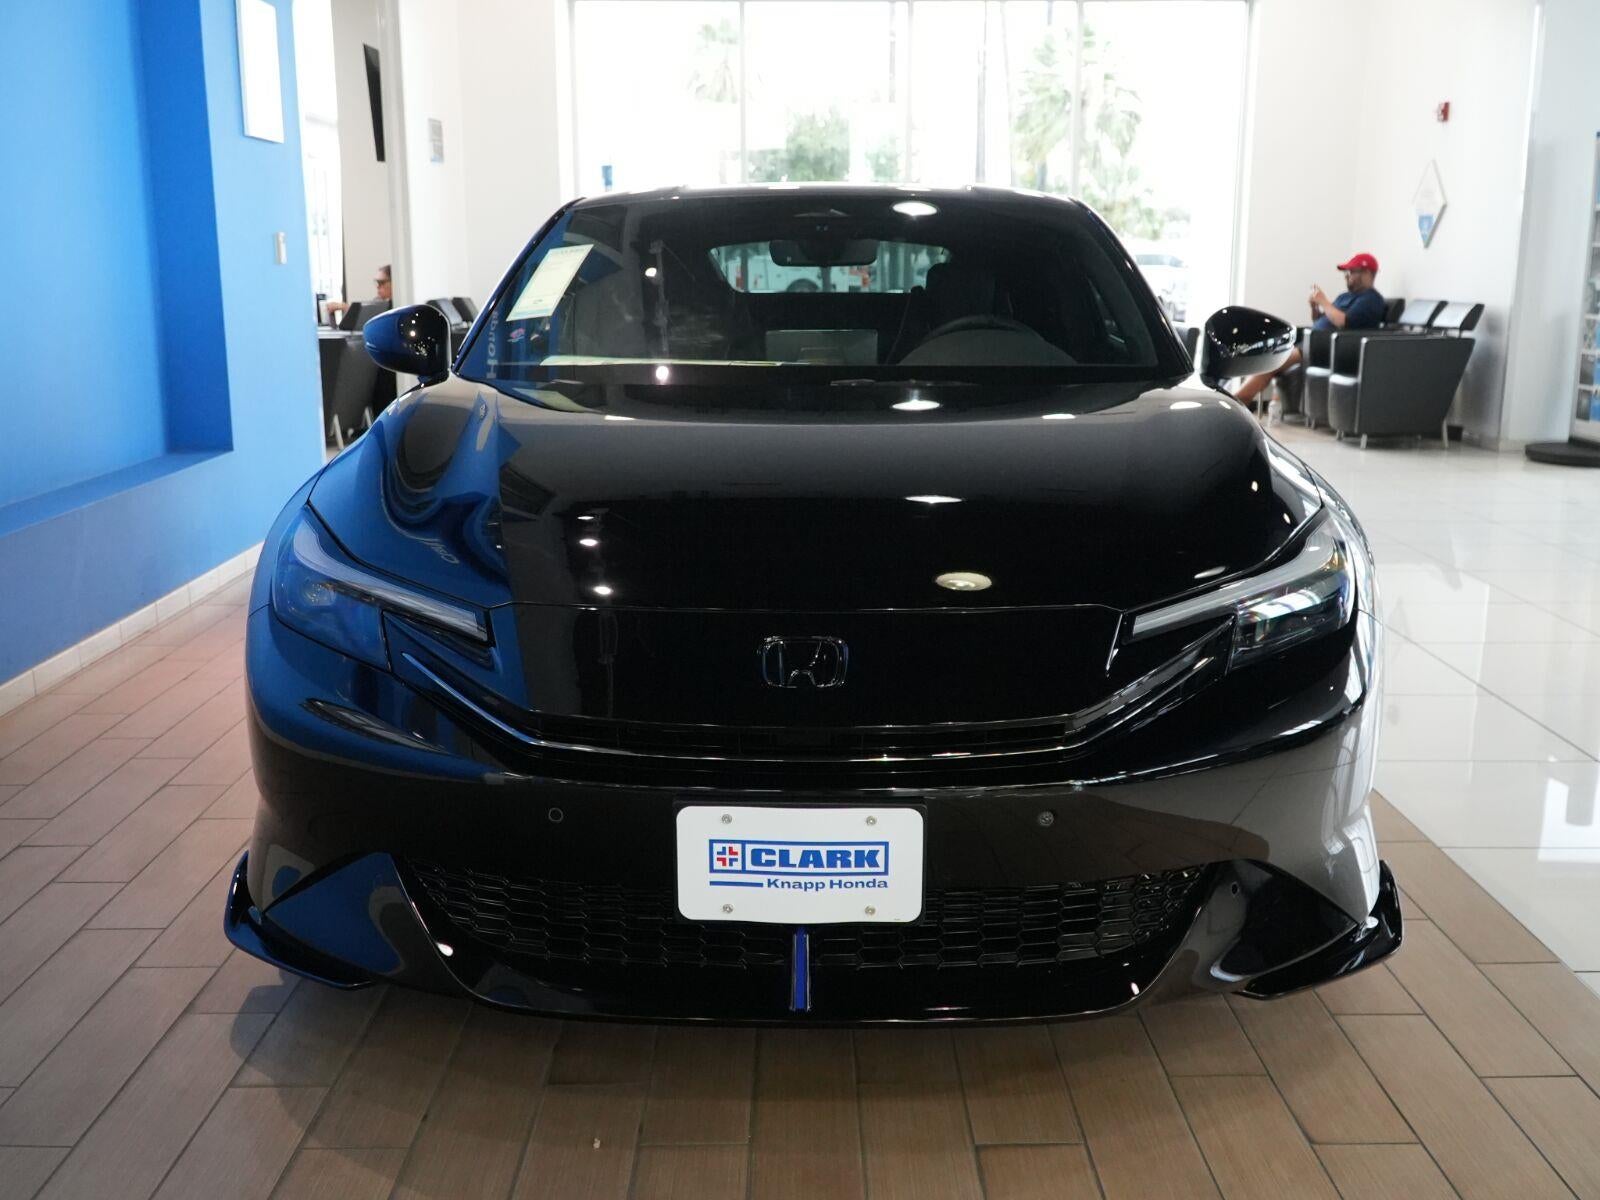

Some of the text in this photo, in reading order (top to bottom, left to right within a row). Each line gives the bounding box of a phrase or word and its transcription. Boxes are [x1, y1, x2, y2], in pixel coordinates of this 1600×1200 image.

[750, 848, 880, 868] CLARK
[767, 878, 888, 891] Knapp Honda
